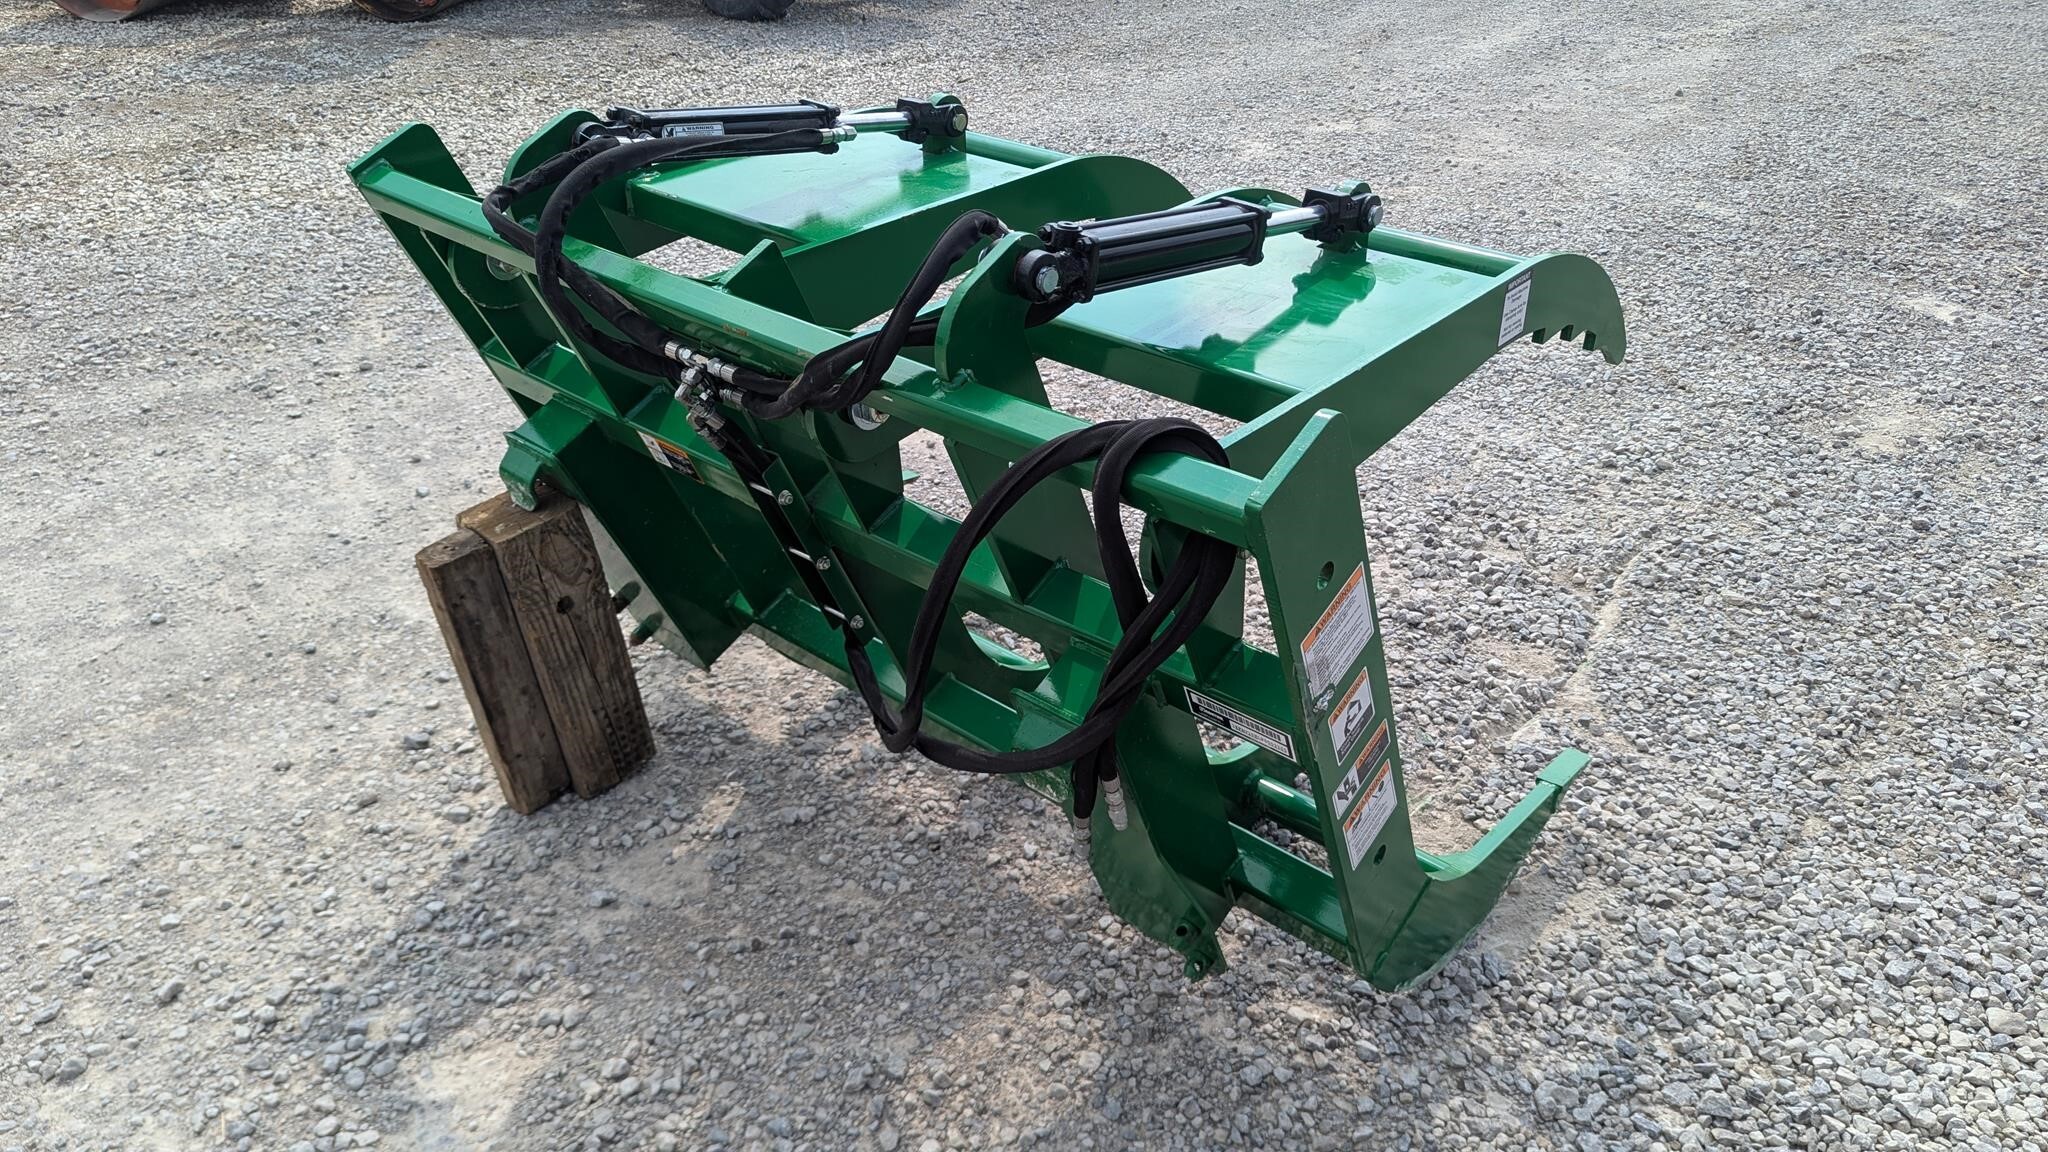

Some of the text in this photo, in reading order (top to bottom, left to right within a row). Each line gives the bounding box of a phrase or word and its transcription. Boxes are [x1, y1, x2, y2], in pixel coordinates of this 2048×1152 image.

[1319, 582, 1353, 629] WARNING
[1337, 670, 1366, 715] WARNING
[1352, 767, 1387, 818] WARNING
